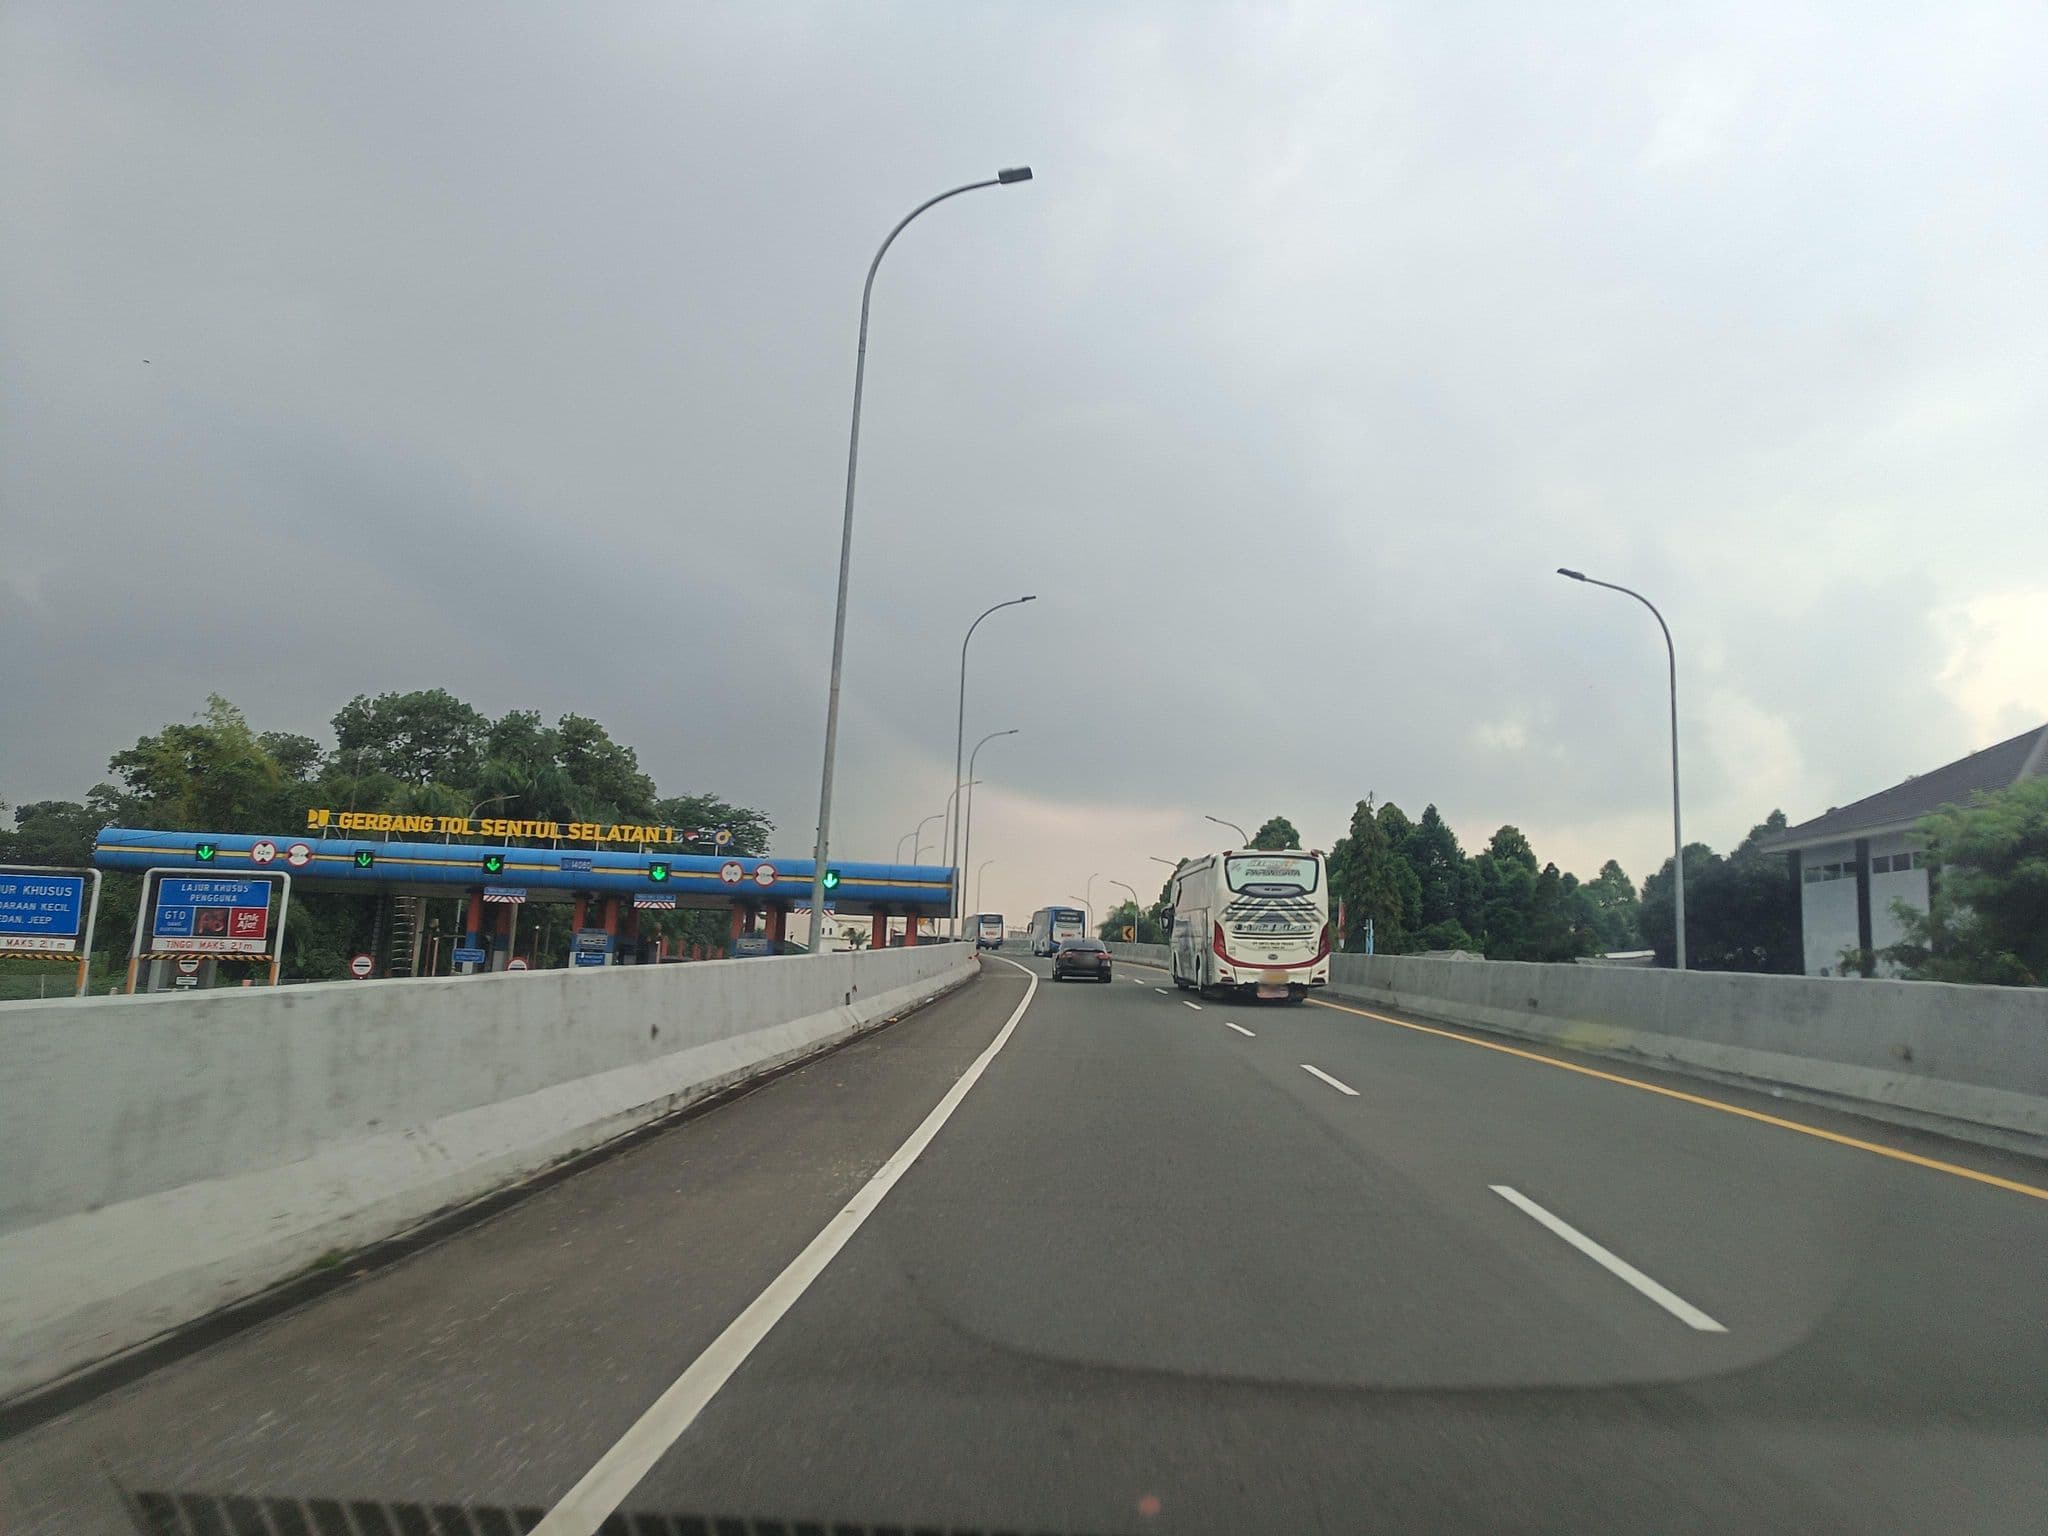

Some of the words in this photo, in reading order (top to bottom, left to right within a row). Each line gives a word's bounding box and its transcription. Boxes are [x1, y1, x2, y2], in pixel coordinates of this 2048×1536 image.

[339, 812, 434, 833] GERBANG
[437, 816, 475, 836] TOL
[480, 818, 561, 839] SENTUL
[568, 823, 659, 844] SELATAN
[665, 827, 673, 844] 1
[0, 884, 17, 895] UR
[22, 885, 73, 897] KHUSUS
[181, 884, 210, 892] LAJUR
[214, 884, 249, 893] KHUSUS
[190, 894, 238, 902] PENGGUNA
[41, 902, 71, 912] KECIL
[165, 910, 186, 920] GTO
[27, 916, 53, 925] JEEP
[6, 939, 33, 948] MAKS
[166, 940, 193, 949] TINGGI
[200, 941, 225, 950] MAKS
